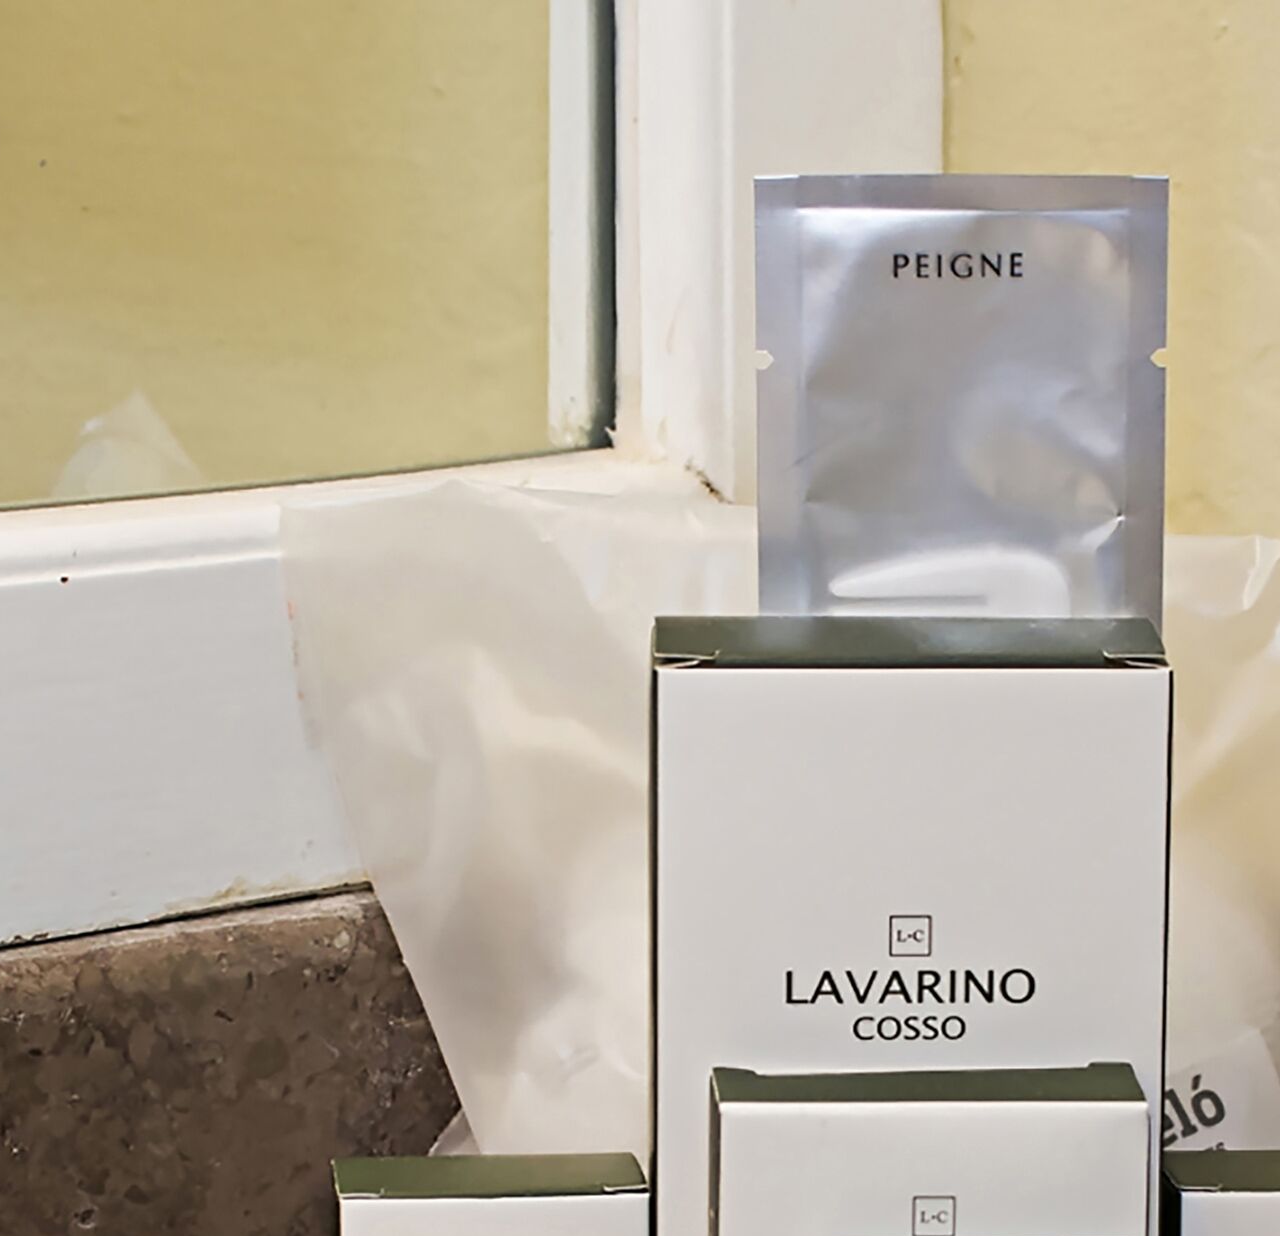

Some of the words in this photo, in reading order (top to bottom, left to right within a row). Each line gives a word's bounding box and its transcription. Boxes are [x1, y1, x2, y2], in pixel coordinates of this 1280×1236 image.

[893, 252, 1023, 280] PEIGNE
[785, 968, 1036, 1005] LAVARINO
[852, 1015, 967, 1041] COSSO
